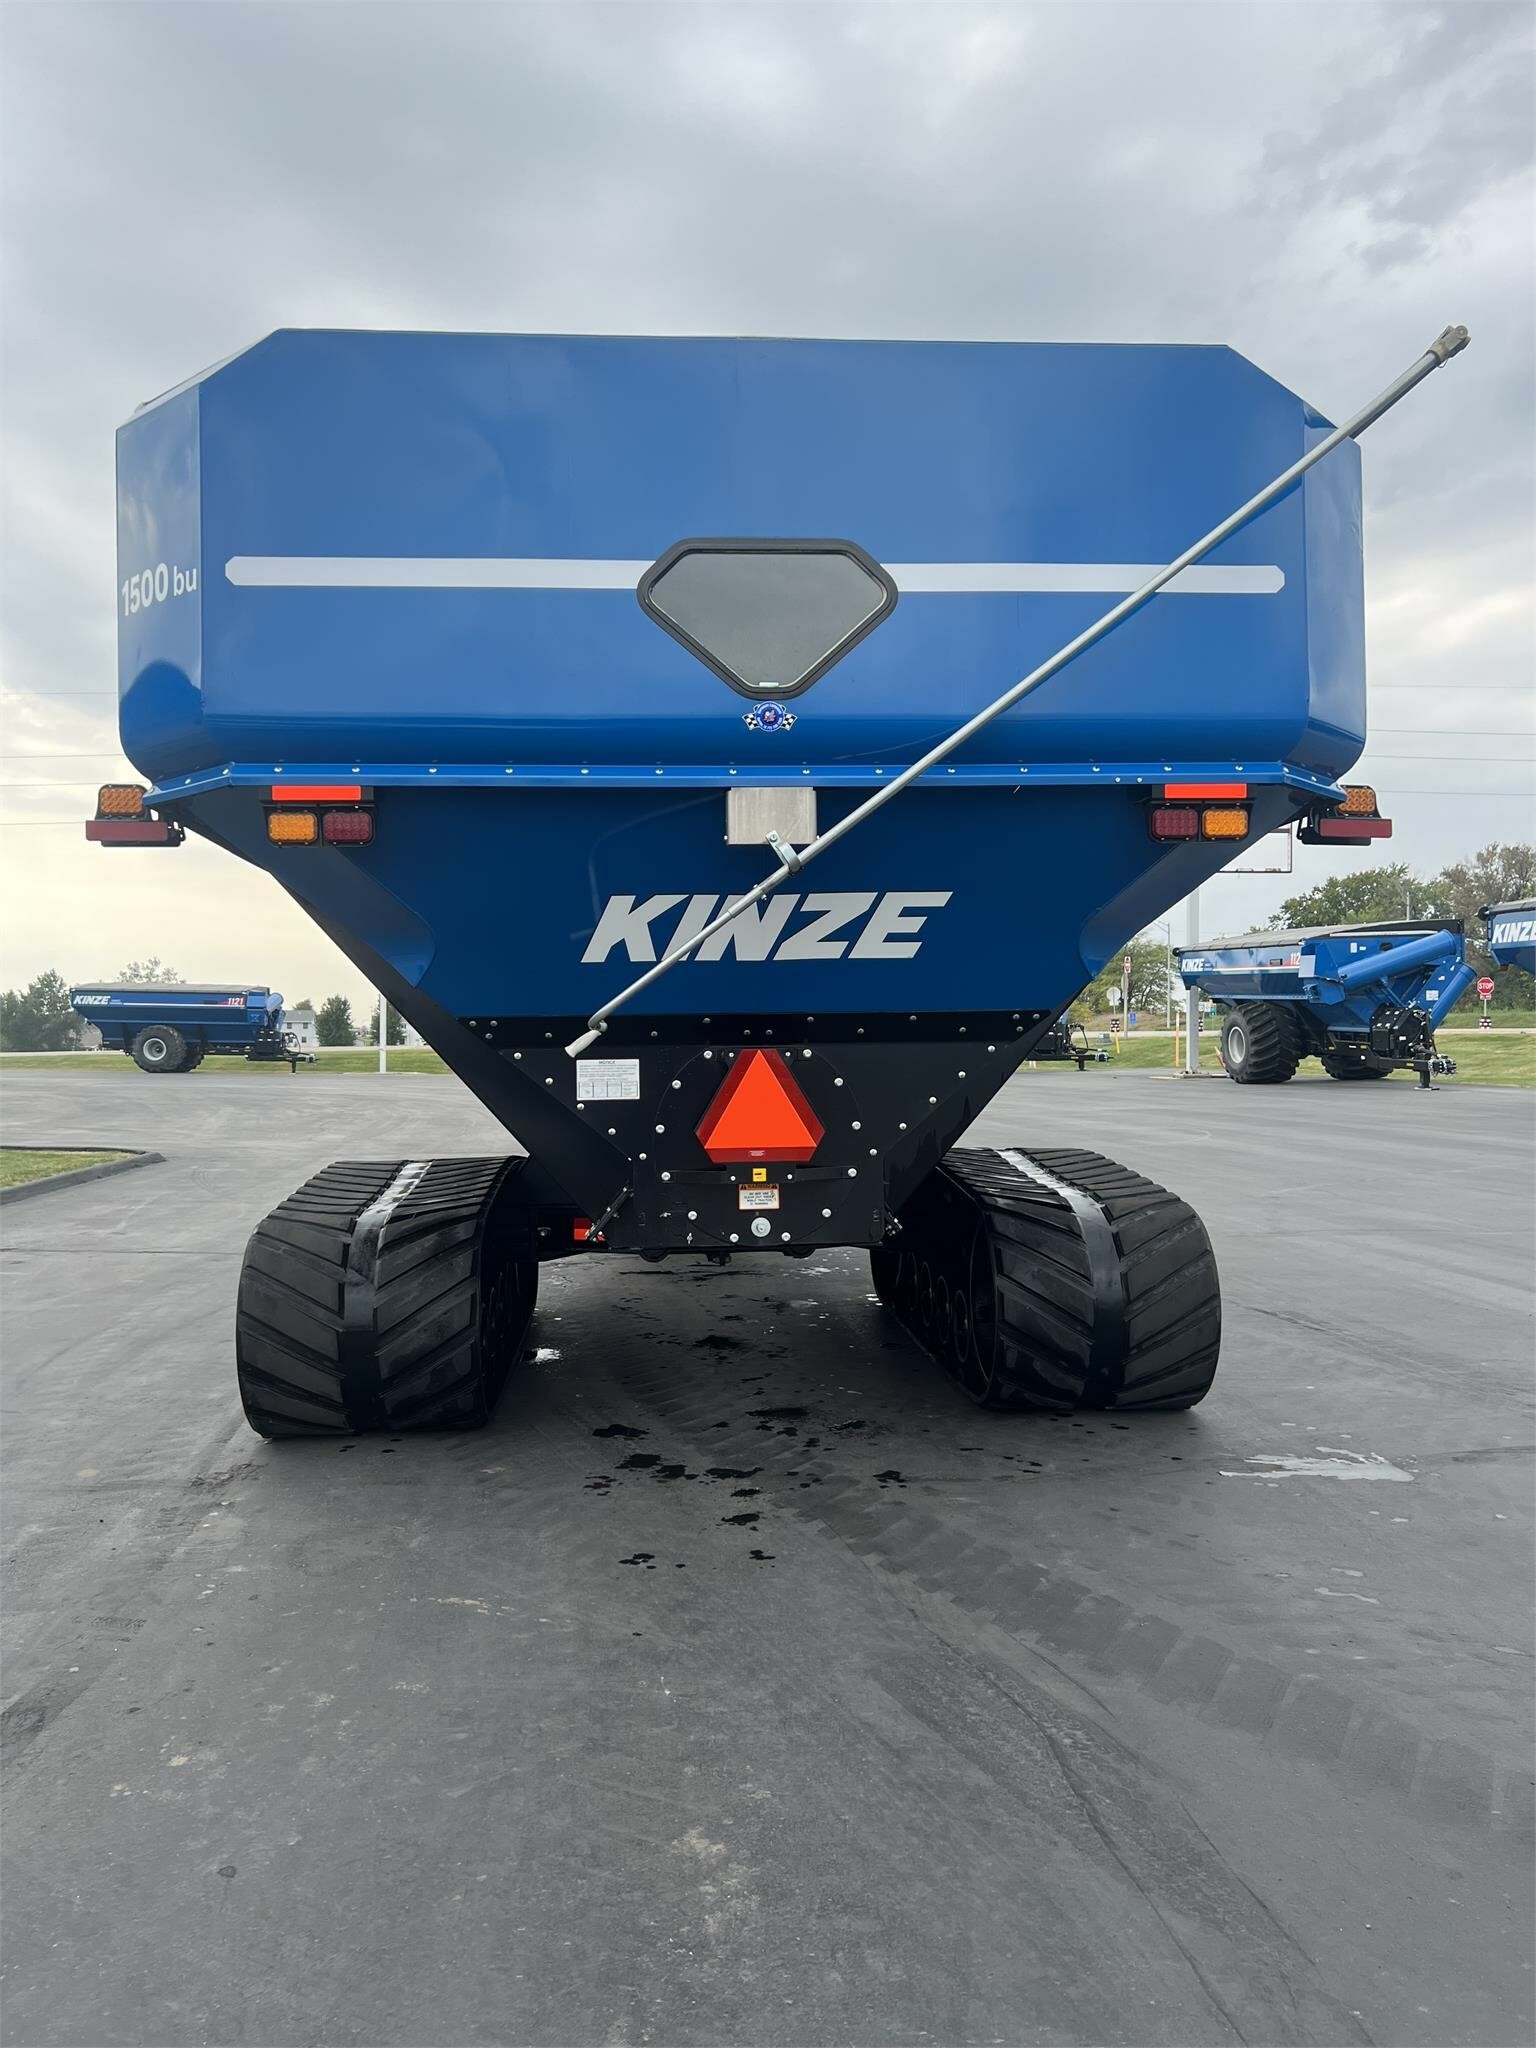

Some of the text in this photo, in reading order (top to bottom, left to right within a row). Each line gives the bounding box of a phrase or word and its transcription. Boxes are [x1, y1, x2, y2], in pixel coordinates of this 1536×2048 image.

[121, 562, 198, 617] 1500 bu
[580, 891, 955, 964] KINZE
[1181, 958, 1205, 973] KINZE
[1289, 951, 1302, 967] 112
[1478, 982, 1493, 990] STOP
[73, 995, 111, 1005] KINZE
[228, 997, 244, 1006] 1121
